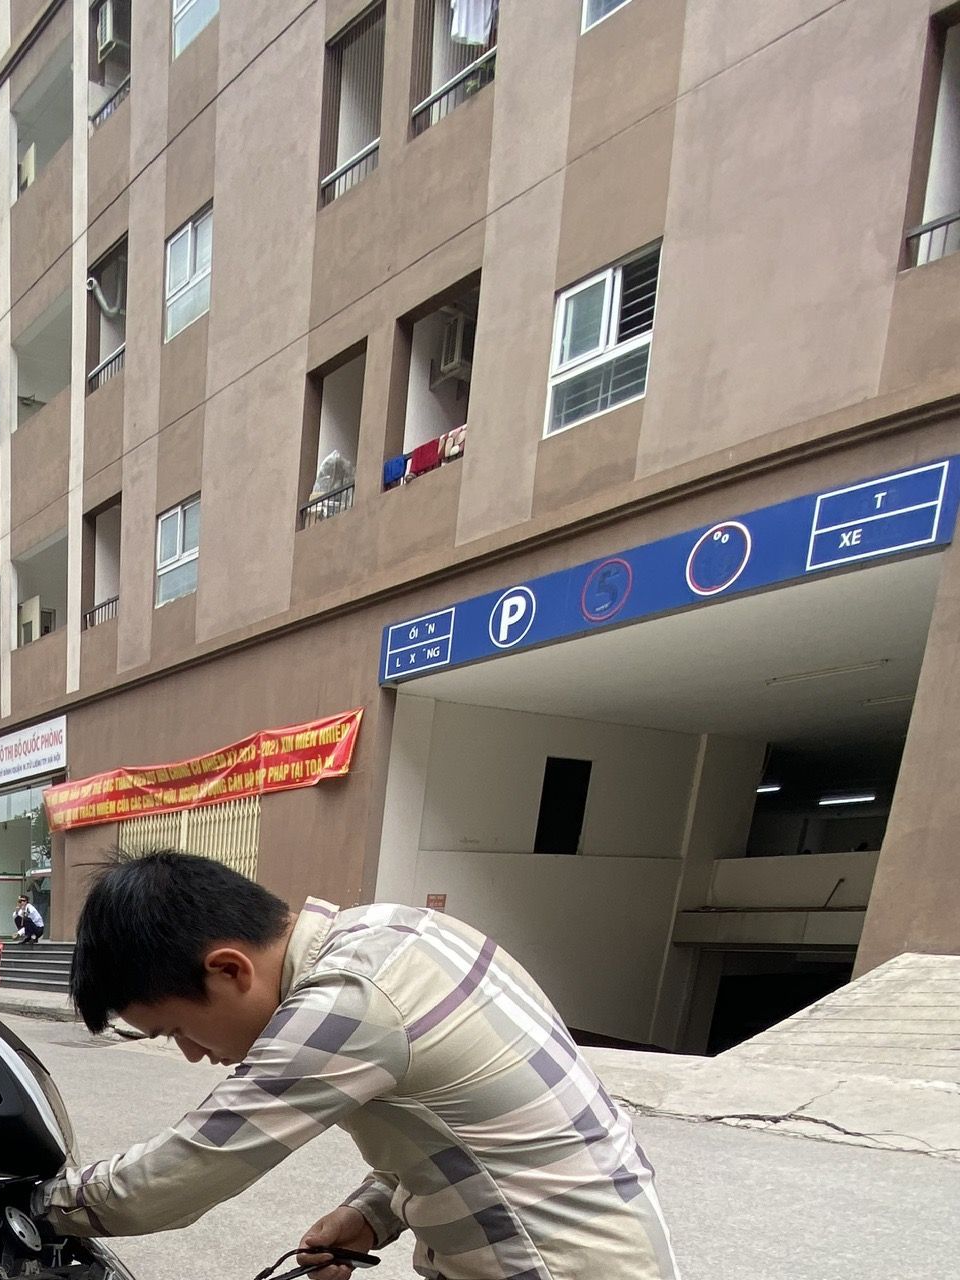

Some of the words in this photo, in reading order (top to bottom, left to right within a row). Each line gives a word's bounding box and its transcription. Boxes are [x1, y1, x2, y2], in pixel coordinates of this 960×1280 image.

[839, 528, 863, 549] XE
[499, 595, 527, 642] P
[23, 732, 40, 756] QUỐC
[41, 727, 63, 751] PHÒNG
